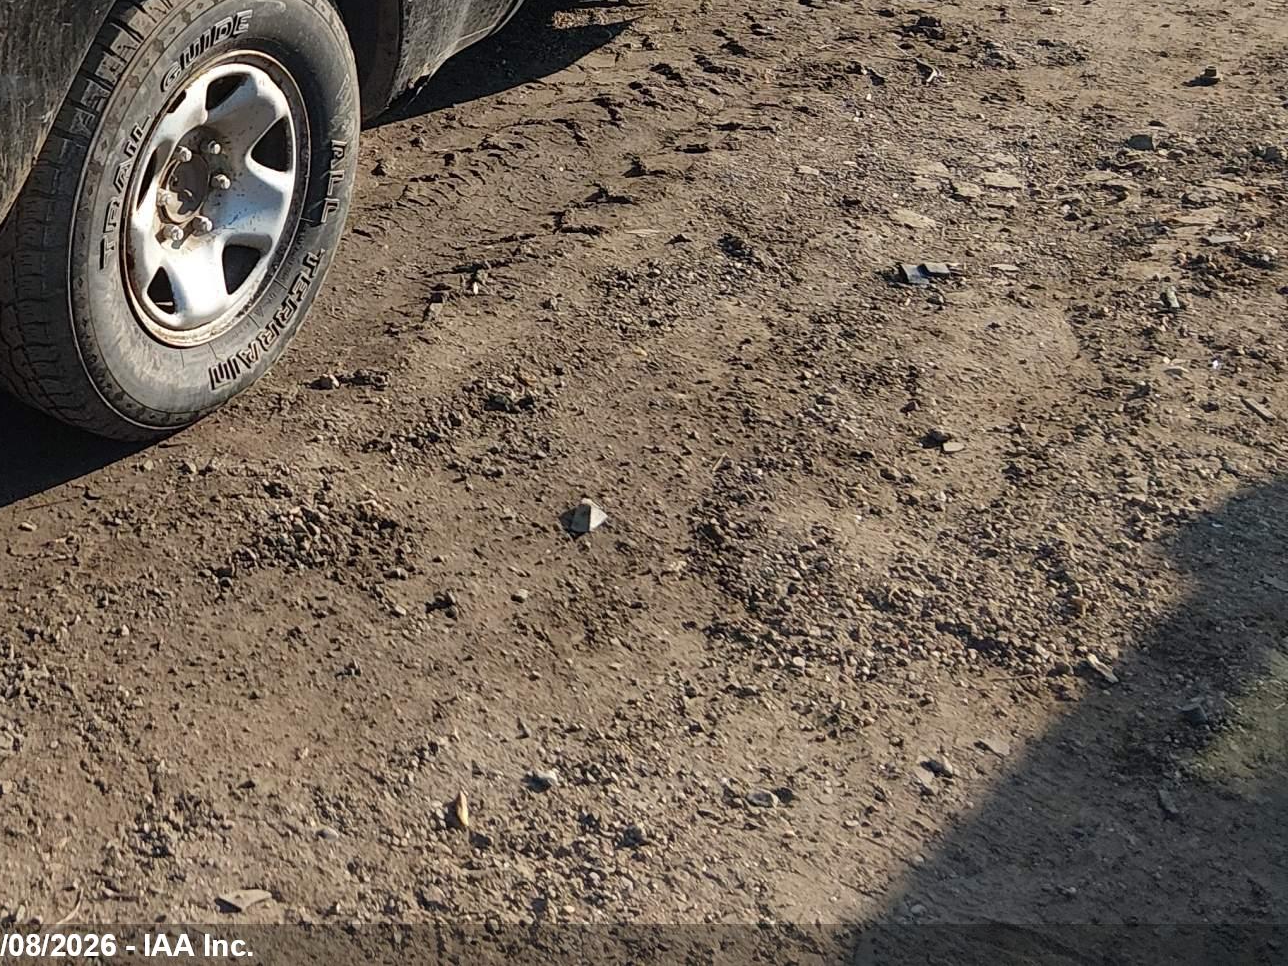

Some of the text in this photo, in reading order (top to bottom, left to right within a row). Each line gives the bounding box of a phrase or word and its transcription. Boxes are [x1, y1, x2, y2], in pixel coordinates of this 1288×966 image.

[100, 9, 253, 270] TRAIL GUIDE
[208, 139, 348, 391] ALL TERRAIN
